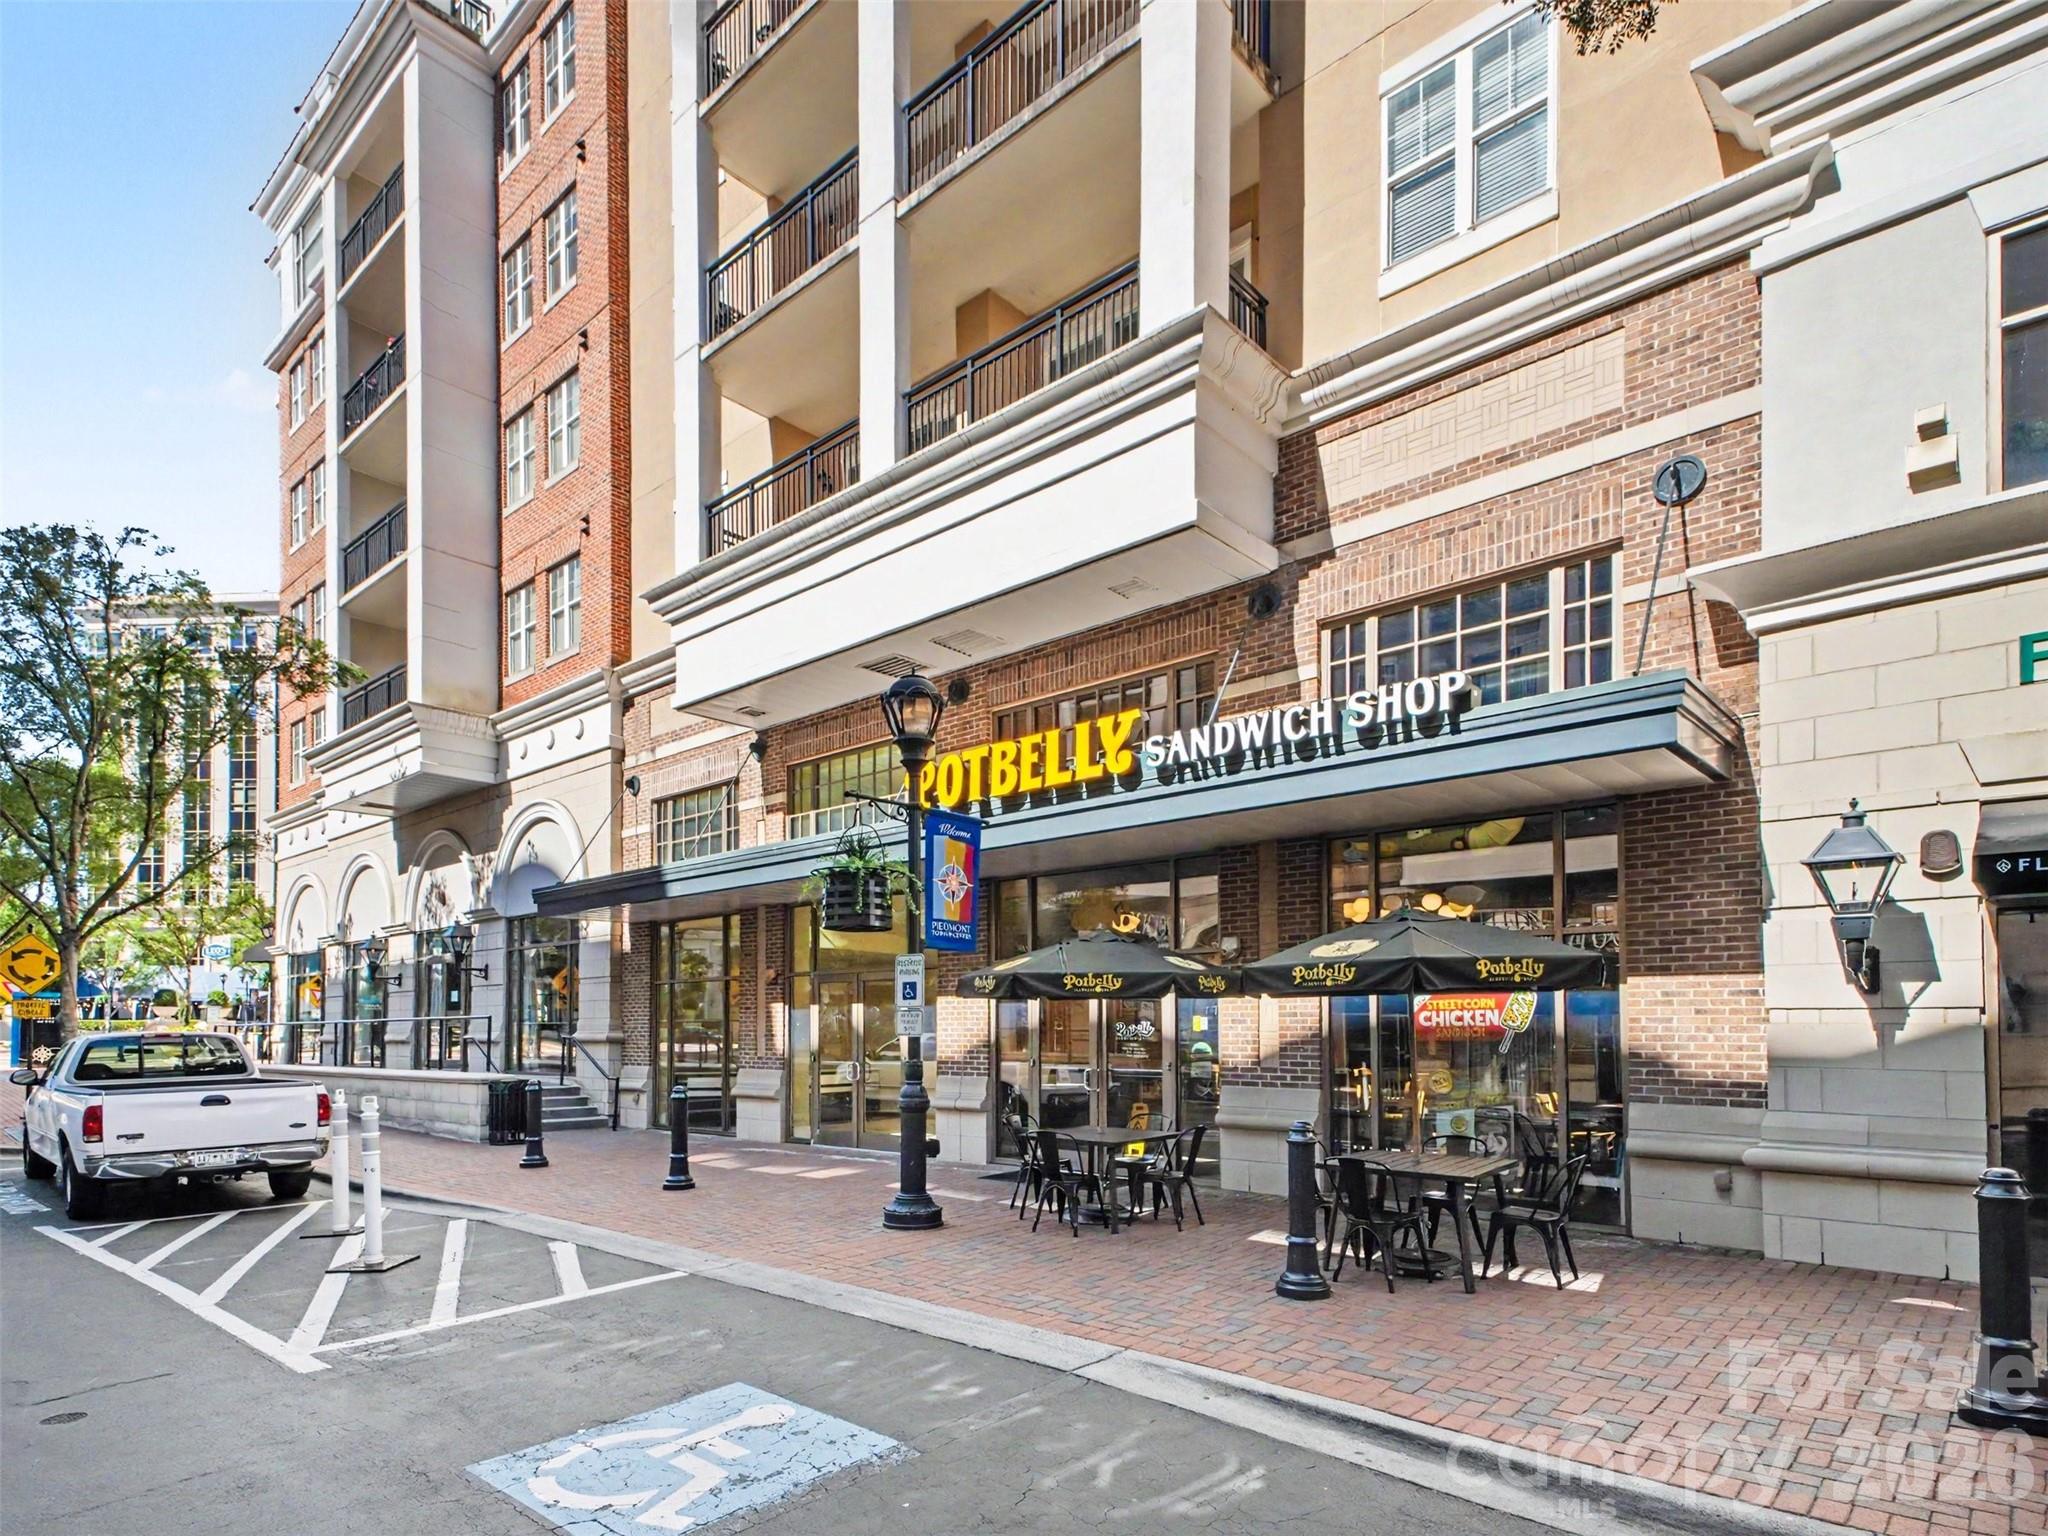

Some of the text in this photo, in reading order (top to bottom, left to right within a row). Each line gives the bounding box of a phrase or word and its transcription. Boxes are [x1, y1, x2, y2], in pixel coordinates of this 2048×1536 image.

[903, 671, 1467, 809] POTBELLY SANDWICH SHOP
[939, 823, 971, 839] Welcome
[931, 921, 971, 933] PIEDMONT
[1292, 963, 1357, 986] Potbelly
[1476, 956, 1544, 982] Potbelly
[1063, 972, 1123, 993] Potbelly
[1418, 1009, 1499, 1027] CHICKEN
